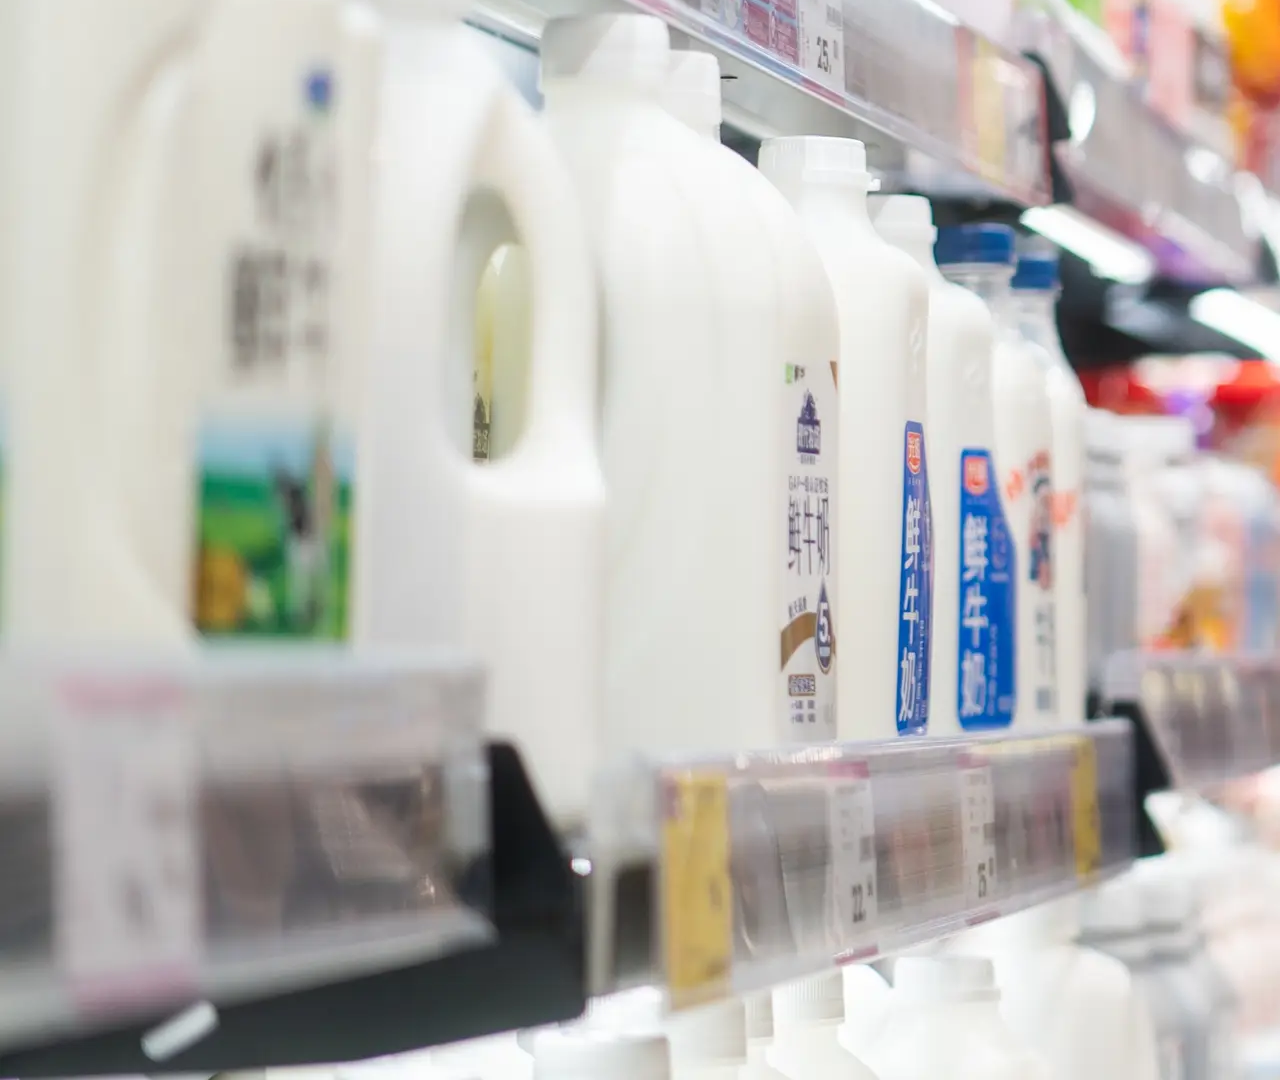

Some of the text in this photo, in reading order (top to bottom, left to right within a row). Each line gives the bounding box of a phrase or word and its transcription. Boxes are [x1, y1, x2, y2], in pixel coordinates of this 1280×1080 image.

[788, 494, 830, 576] 鲜牛奶
[899, 495, 921, 721] 鲜牛奶
[961, 512, 989, 717] 鲜牛奶
